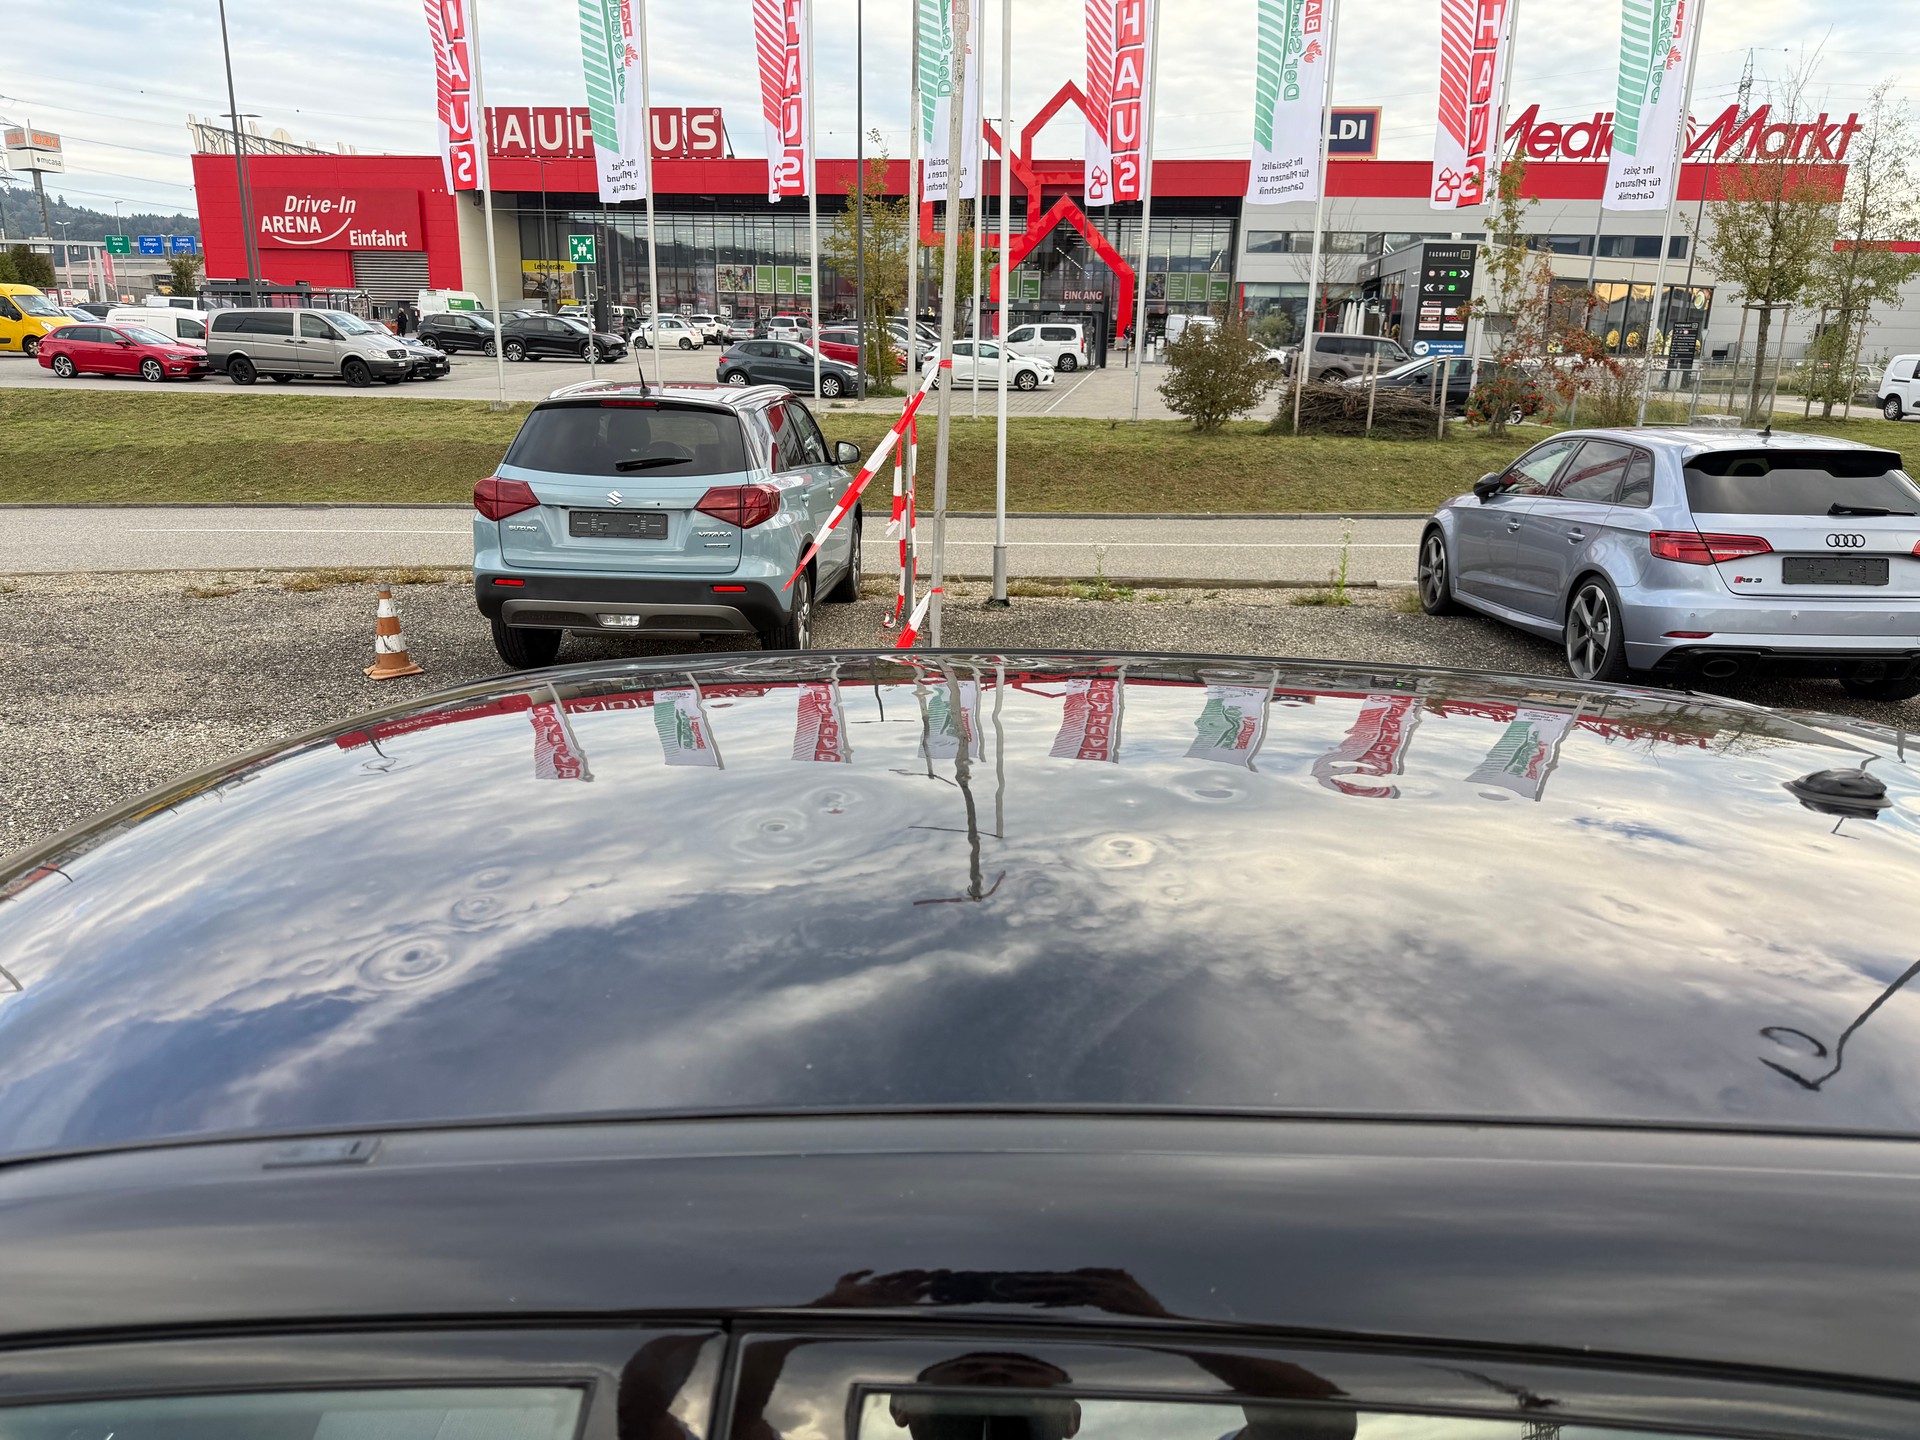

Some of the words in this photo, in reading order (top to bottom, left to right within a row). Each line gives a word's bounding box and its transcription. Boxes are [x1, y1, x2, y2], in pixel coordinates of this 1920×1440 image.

[1328, 119, 1367, 140] LDI
[1504, 104, 1614, 159] Medi
[32, 133, 60, 148] OBI
[284, 195, 357, 214] Drive-In
[261, 215, 322, 234] ARENA
[349, 229, 408, 247] Einfahrt
